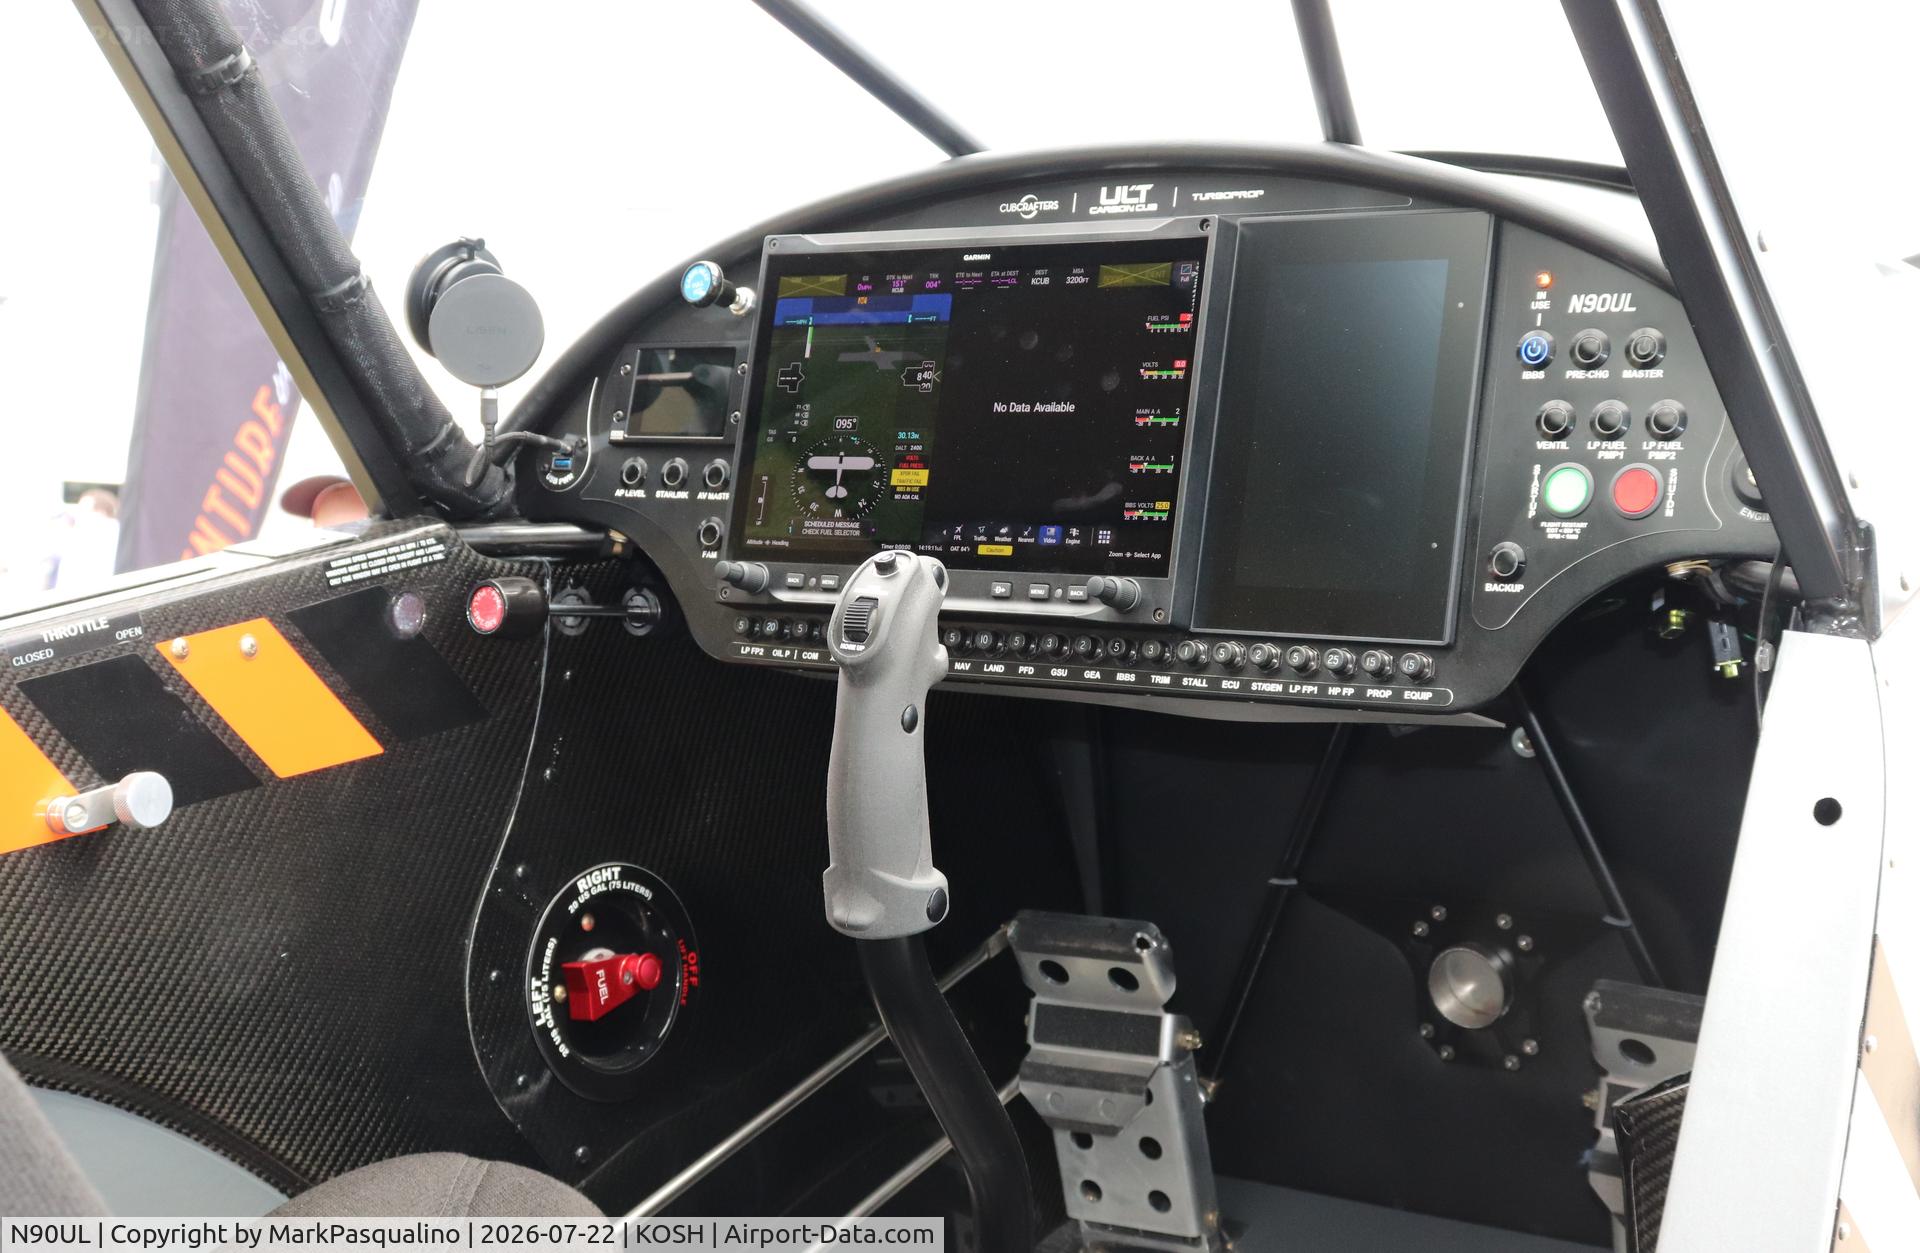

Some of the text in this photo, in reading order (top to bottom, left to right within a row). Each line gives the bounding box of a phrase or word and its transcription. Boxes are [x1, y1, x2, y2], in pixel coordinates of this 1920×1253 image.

[1192, 190, 1264, 201] TURBOPROP
[1000, 199, 1059, 214] CUBCRAFTERS
[1089, 203, 1158, 215] CARBON CUB
[1031, 277, 1049, 285] KCUB
[1531, 301, 1551, 310] USE
[1568, 293, 1637, 313] N90UL
[1522, 371, 1545, 380] IBBS
[1565, 370, 1610, 379] PRE-CHG
[1622, 370, 1664, 379] MASTER
[993, 402, 1076, 413] No Data Available
[836, 418, 857, 429] 095°
[1537, 442, 1570, 450] VENTIL
[1587, 442, 1627, 450] LP FUEL
[1642, 442, 1684, 450] LP FUEL
[1598, 452, 1624, 460] PMP1
[1648, 452, 1676, 460] PMP2
[615, 489, 646, 498] AP LEVEL
[655, 490, 689, 499] STARLINK
[697, 491, 707, 500] AV
[804, 520, 860, 529] SCHEDULED MESSAGE
[1485, 583, 1524, 592] BACKUP
[40, 616, 110, 643] THROTTLE
[766, 621, 776, 631] 20
[115, 626, 143, 641] OPEN
[950, 633, 956, 642] 5
[980, 634, 989, 644] 10
[1014, 636, 1020, 646] 5
[1046, 639, 1052, 648] 3
[1080, 640, 1086, 650] 2
[1113, 642, 1120, 652] 5
[740, 646, 764, 655] LP FP2
[772, 648, 784, 656] OIL
[802, 651, 819, 660] COM
[1219, 648, 1225, 658] 5
[1255, 650, 1262, 659] 2
[12, 648, 54, 667] CLOSED
[1292, 652, 1299, 663] 5
[1327, 655, 1340, 665] 25
[1366, 657, 1376, 667] 15
[954, 662, 971, 671] NAV
[984, 664, 1005, 673] LAND
[1405, 659, 1415, 669] 15
[1018, 665, 1034, 675] PFD
[1050, 668, 1068, 677] GSU
[1084, 670, 1101, 680] GEA
[1116, 672, 1135, 682] IBBS
[1151, 675, 1171, 685] TRIM
[1182, 677, 1208, 687] STALL
[1221, 680, 1240, 689] ECU
[1251, 682, 1282, 693] ST/GEN
[1289, 684, 1318, 695] LP FP1
[1328, 686, 1354, 697] HP FP
[1366, 688, 1392, 699] PROP
[1404, 690, 1432, 701] EQUIP
[577, 866, 621, 893] RIGHT
[568, 880, 653, 914] 20 US GAL (75 LITERS)
[541, 937, 557, 982] LITERS)
[688, 951, 699, 987] OFF
[596, 969, 610, 1005] FUEL
[531, 976, 546, 1027] LEFT
